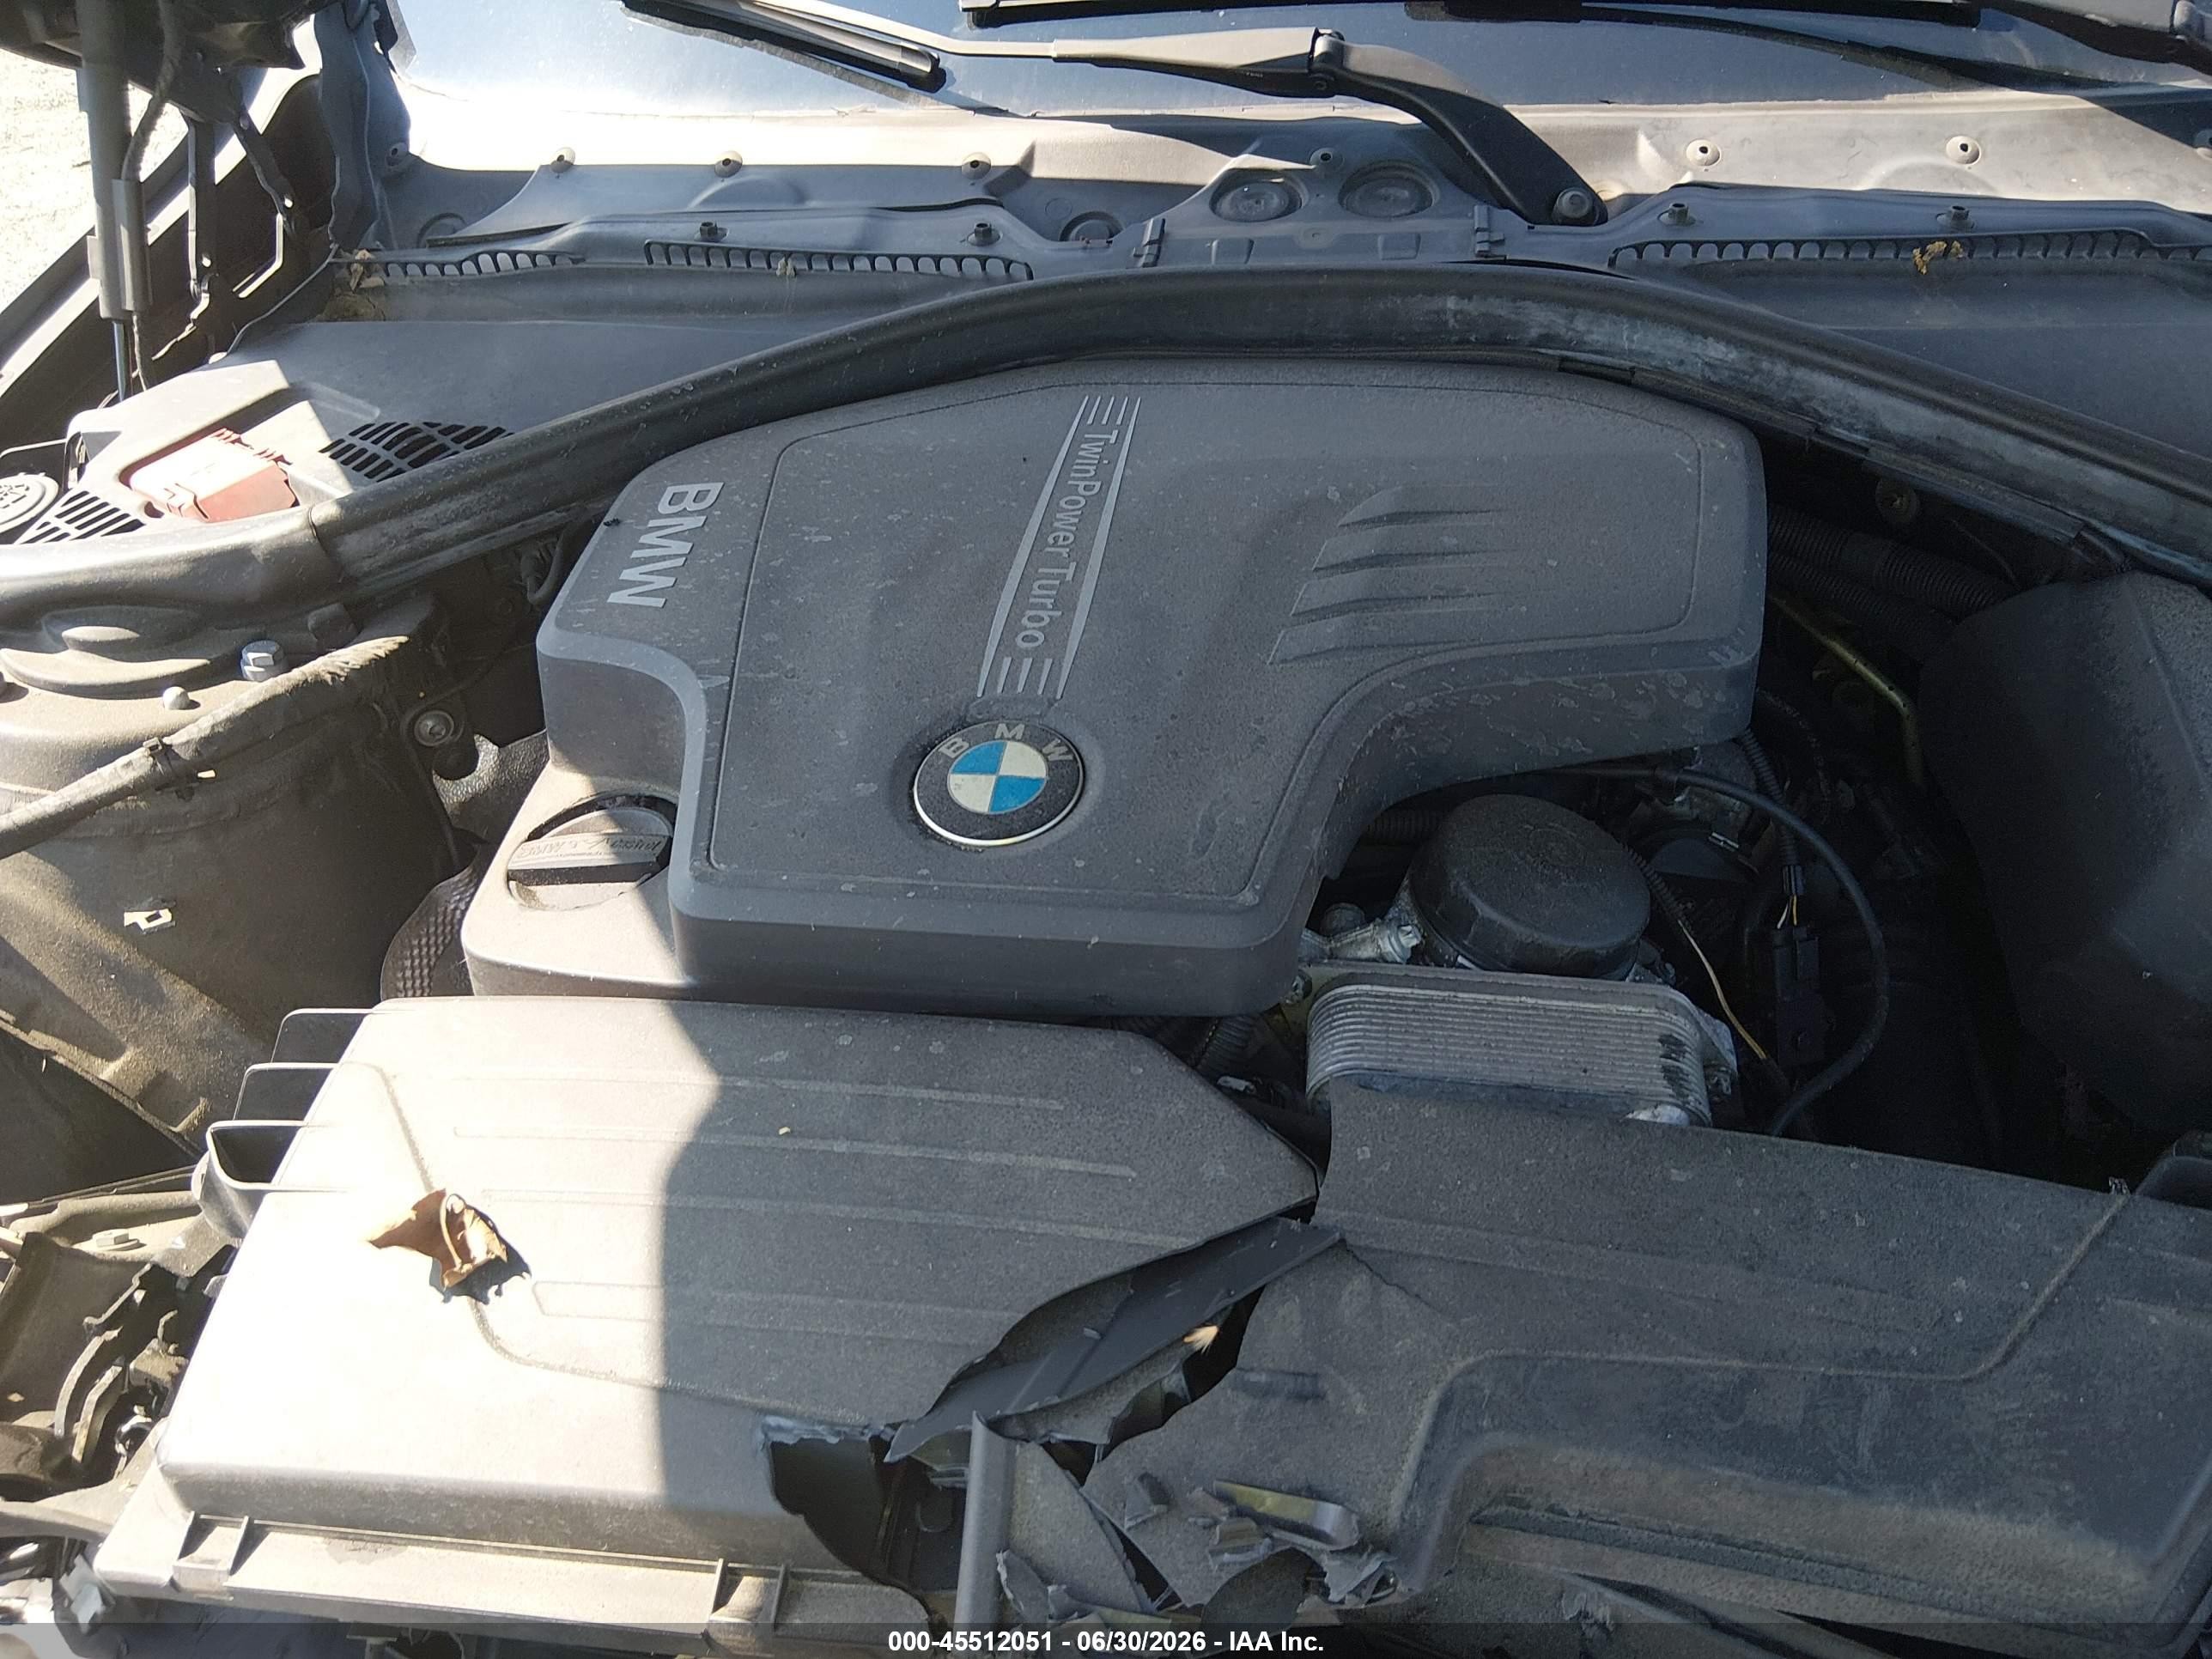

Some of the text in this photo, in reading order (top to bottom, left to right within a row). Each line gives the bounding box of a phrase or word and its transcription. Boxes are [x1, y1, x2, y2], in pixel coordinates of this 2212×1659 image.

[607, 482, 725, 608] BMW
[1015, 430, 1118, 649] TwinPower Turbo
[939, 723, 1074, 762] BMW
